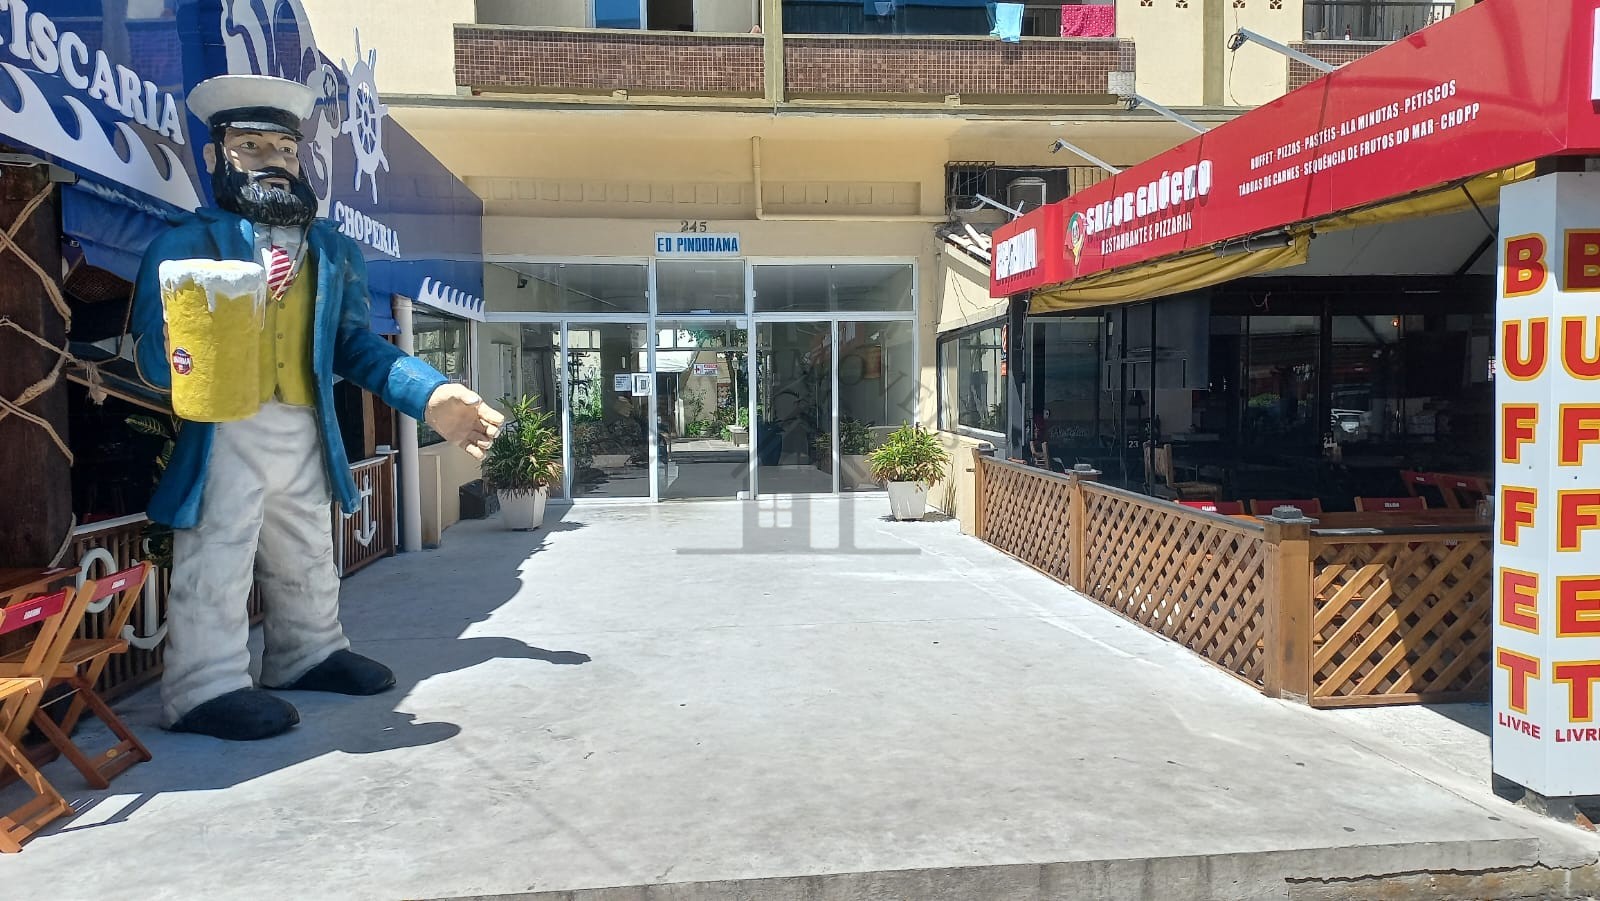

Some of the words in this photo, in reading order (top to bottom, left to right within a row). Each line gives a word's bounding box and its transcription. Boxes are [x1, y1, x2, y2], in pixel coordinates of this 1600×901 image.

[1250, 151, 1274, 170] BUFFET
[1277, 140, 1301, 160] PIZZAS
[1304, 126, 1336, 150] PASTÉIS
[1340, 118, 1356, 137] ALA
[1357, 102, 1399, 131] MINUTAS
[1404, 79, 1456, 114] PETISCOS
[1263, 174, 1272, 188] DE
[1273, 165, 1300, 185] CARNES
[1303, 149, 1346, 176] SEQUÊNCIA
[1347, 144, 1358, 161] DE
[1359, 132, 1394, 157] FRUTOS
[1396, 127, 1410, 145] DO
[1411, 118, 1434, 140] MAR
[1440, 102, 1480, 130] CHOPP
[334, 200, 401, 259] CHOPERIA
[657, 237, 672, 252] ED
[676, 237, 739, 252] PINDORAMA
[680, 220, 708, 233] 245
[1101, 225, 1148, 255] RESTAURANTE
[1148, 224, 1153, 241] E
[1154, 212, 1192, 241] PIZZARIA
[1497, 233, 1548, 714] BUFFET
[1499, 711, 1541, 740] LIVRE
[1555, 727, 1600, 743] LIVR
